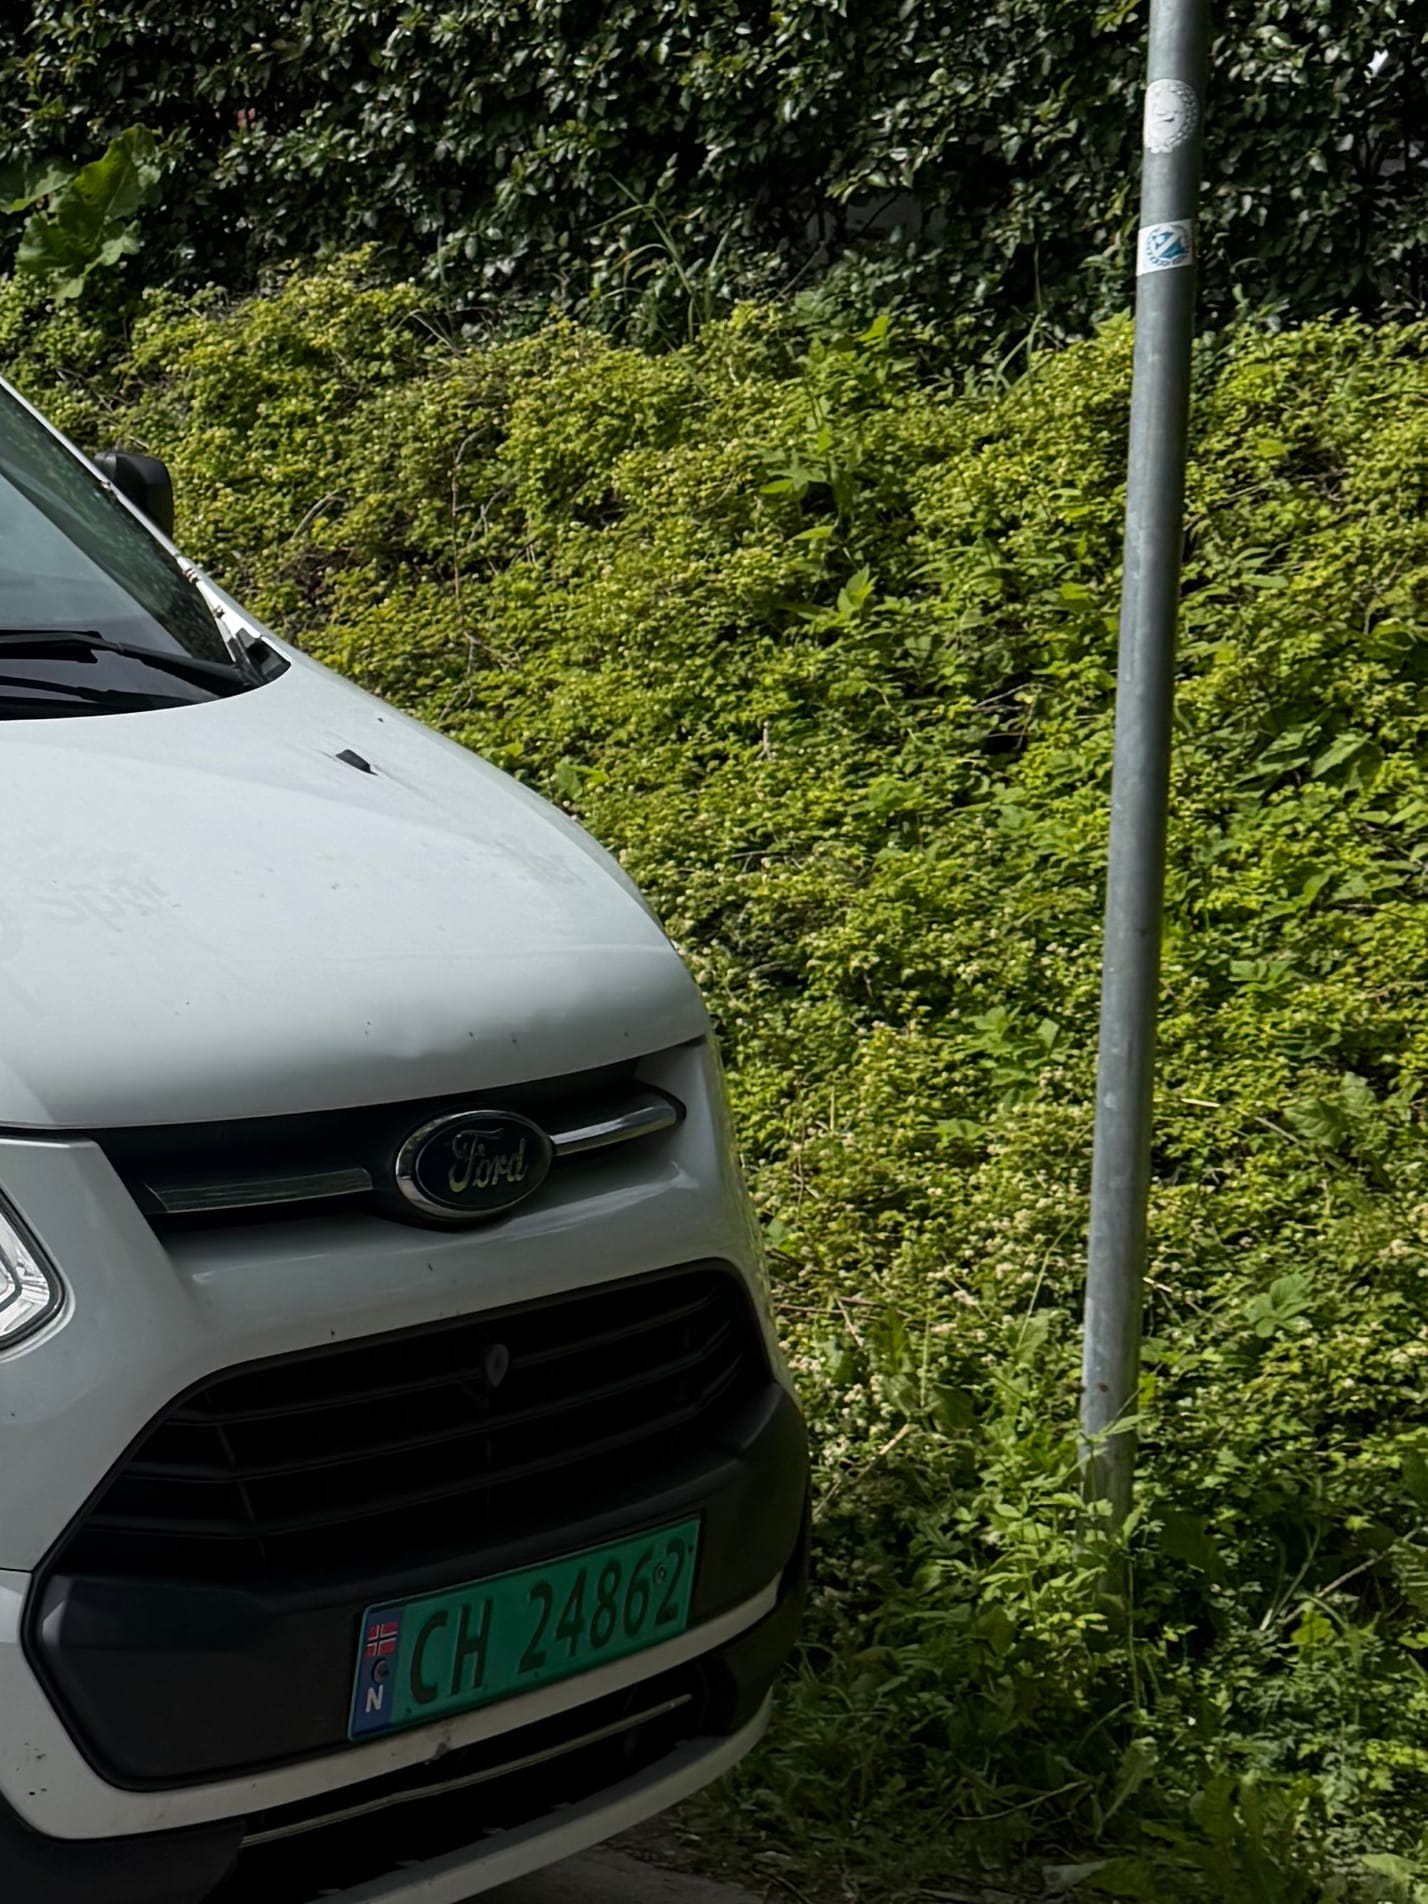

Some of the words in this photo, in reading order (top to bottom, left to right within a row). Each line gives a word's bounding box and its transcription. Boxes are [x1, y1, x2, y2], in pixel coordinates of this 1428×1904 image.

[447, 1127, 529, 1193] Ford
[409, 1598, 493, 1705] CH
[517, 1536, 686, 1674] 24862
[364, 1686, 385, 1713] N
